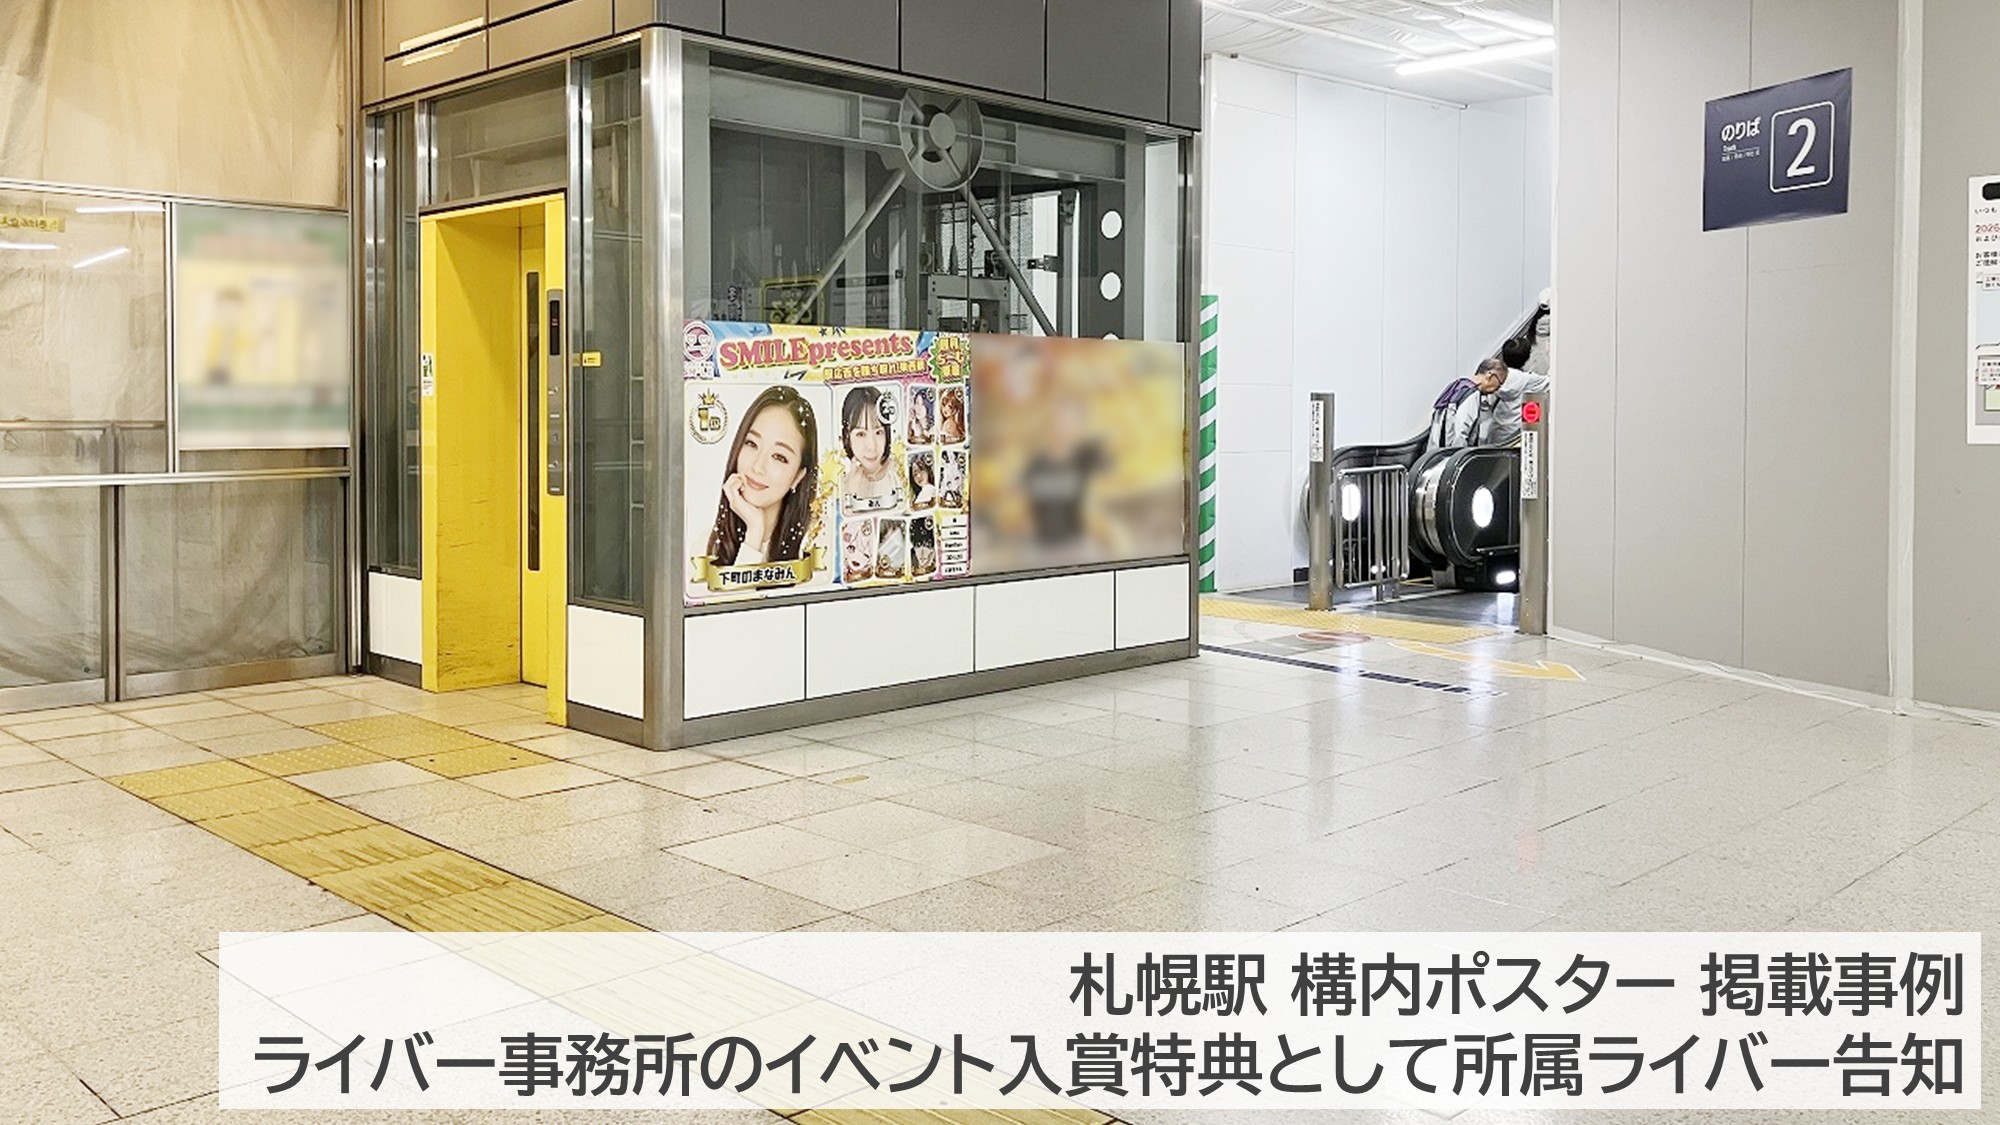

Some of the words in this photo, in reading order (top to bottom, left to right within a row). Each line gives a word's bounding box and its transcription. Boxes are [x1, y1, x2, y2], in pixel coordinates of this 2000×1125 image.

[1721, 116, 1762, 142] のりば
[1786, 117, 1817, 178] 2
[718, 566, 796, 586] 下町のまなみん
